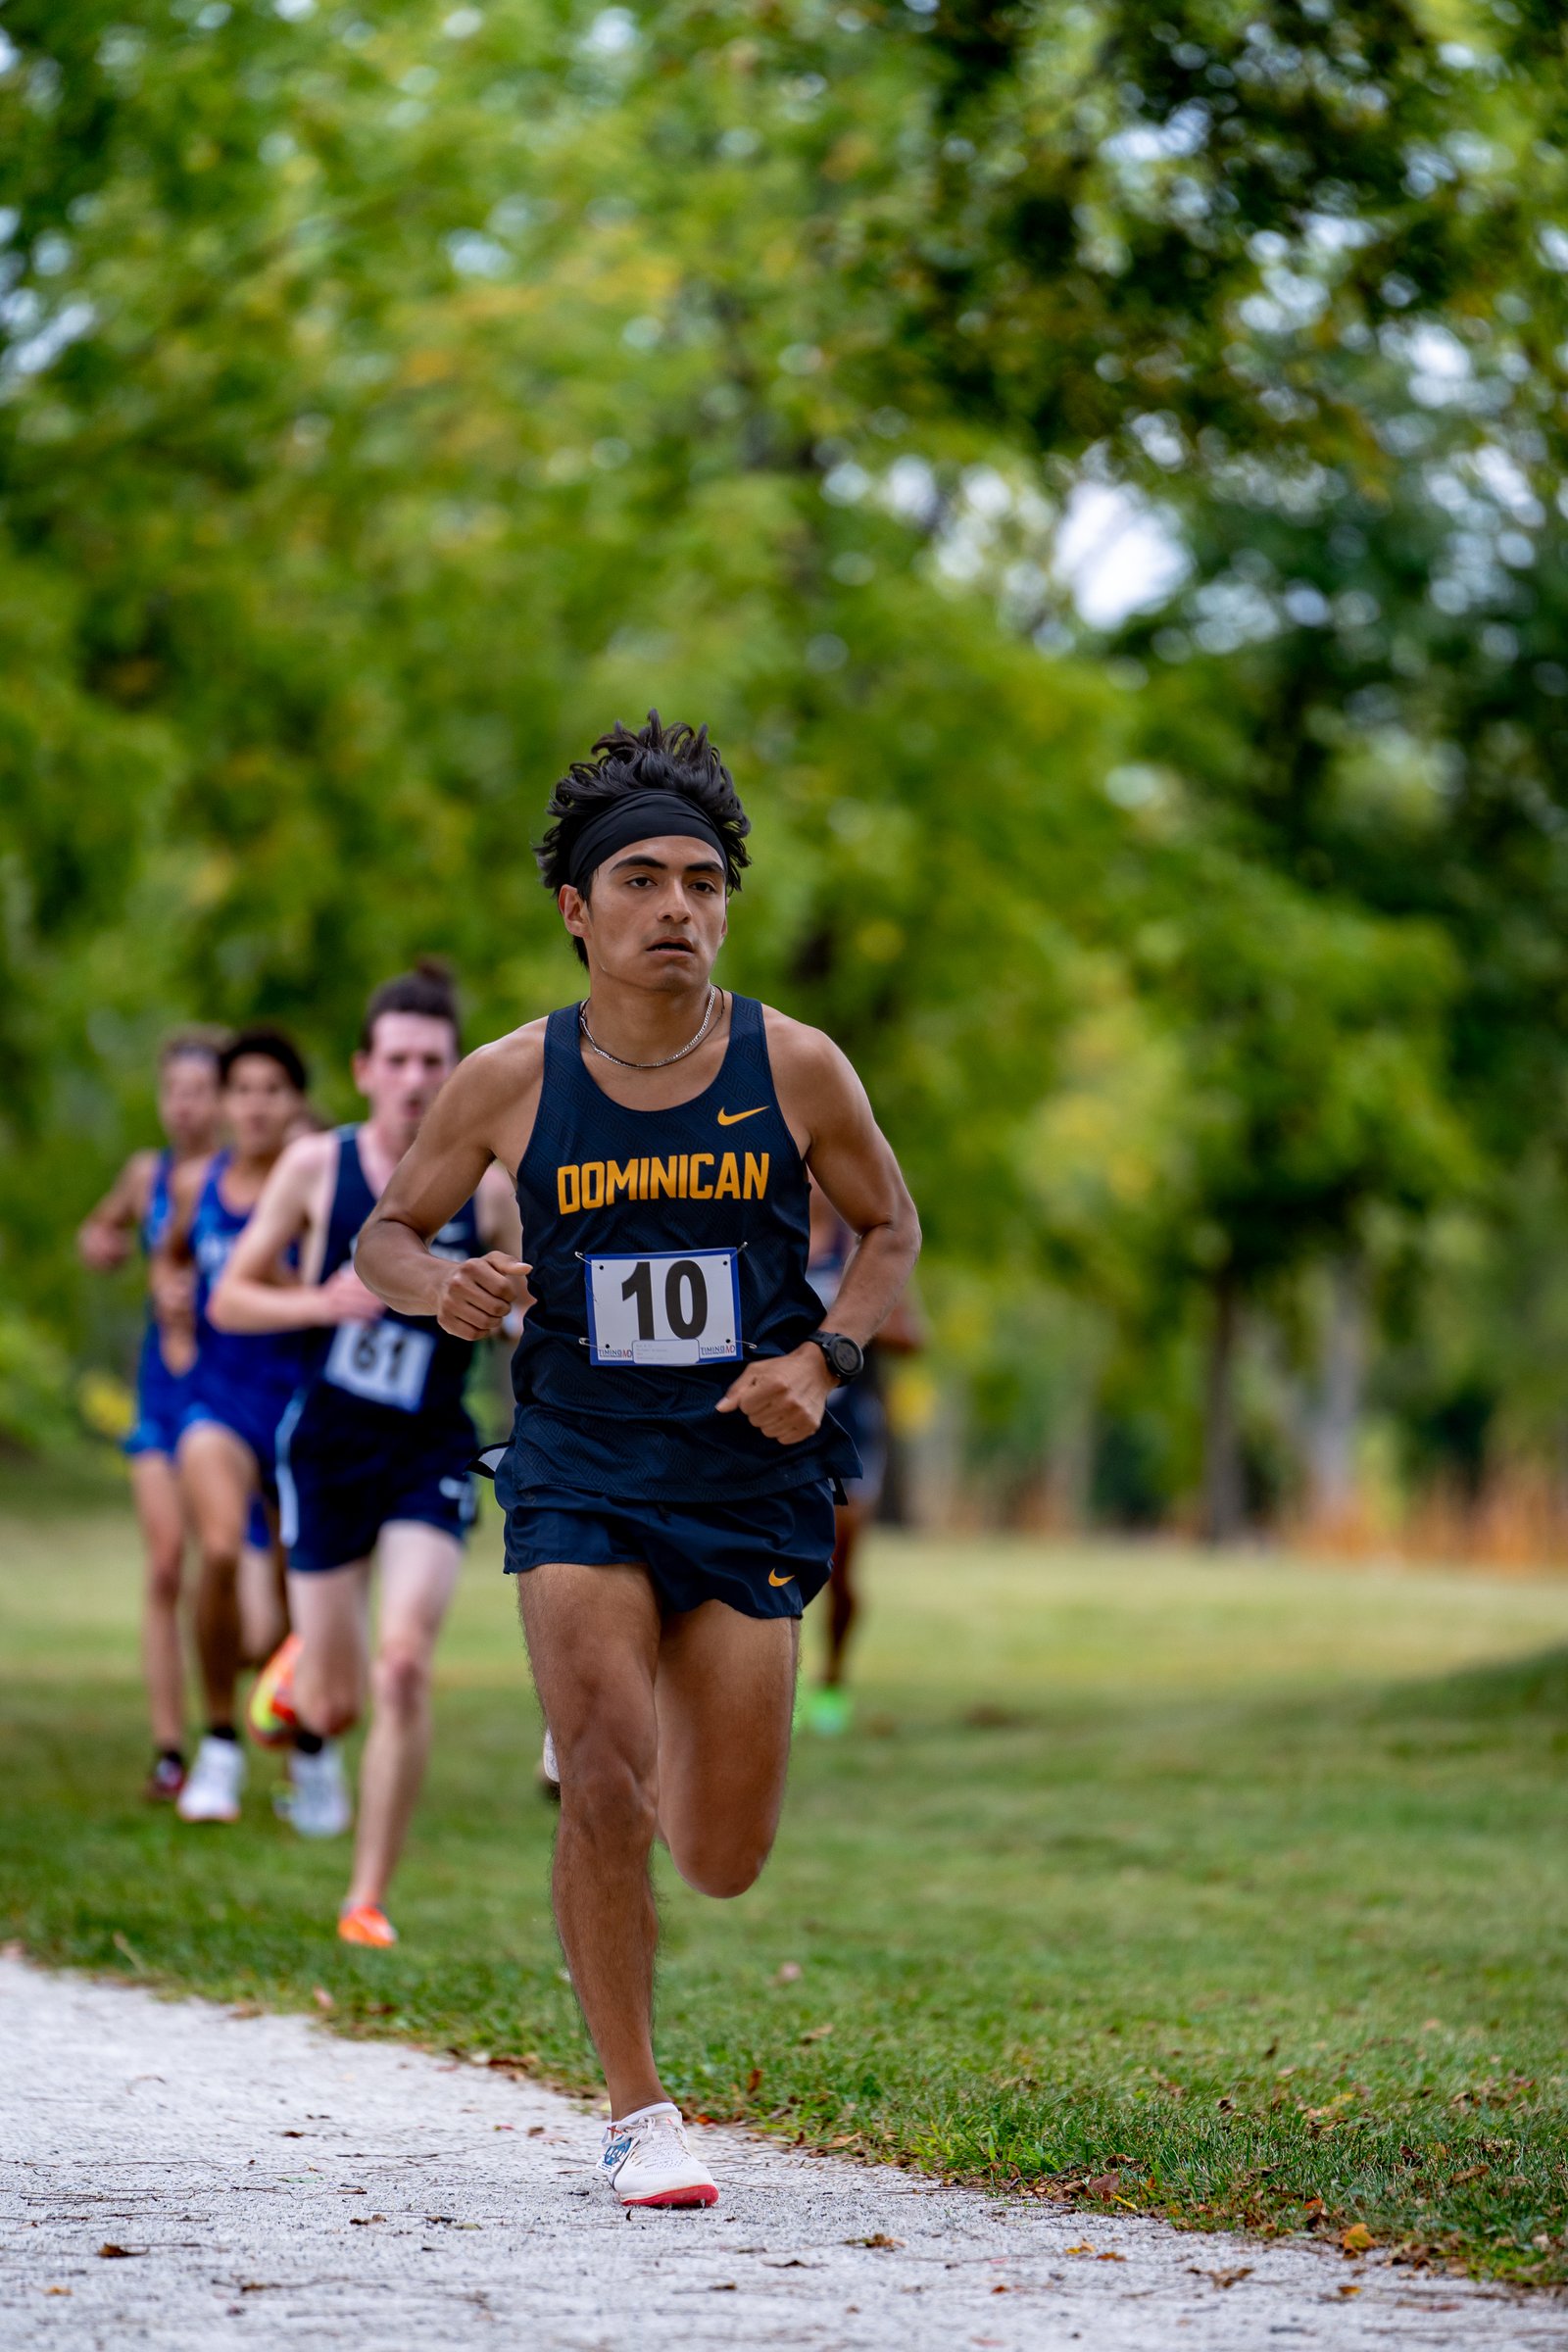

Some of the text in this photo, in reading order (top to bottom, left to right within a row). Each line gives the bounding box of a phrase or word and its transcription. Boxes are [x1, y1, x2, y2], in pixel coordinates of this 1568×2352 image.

[557, 1152, 770, 1215] DOMINICAN
[621, 1259, 709, 1341] 10
[351, 1328, 409, 1383] 61
